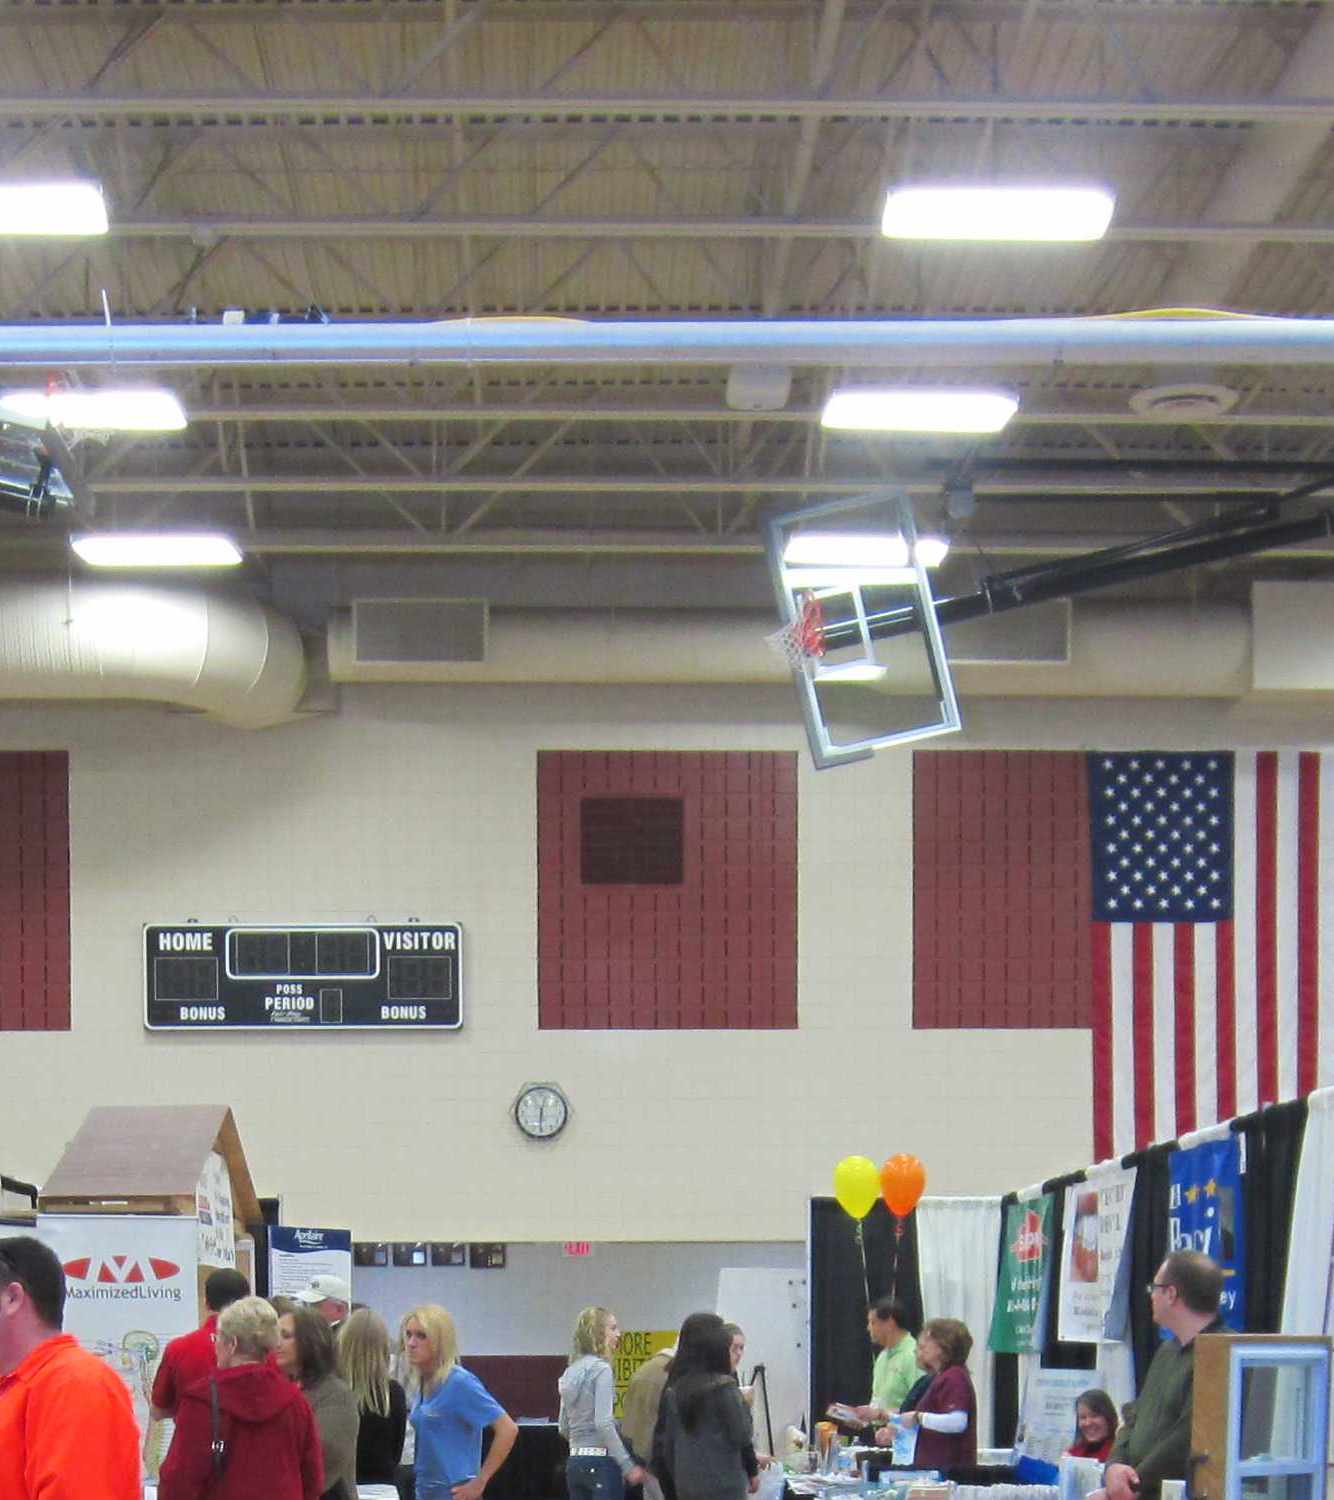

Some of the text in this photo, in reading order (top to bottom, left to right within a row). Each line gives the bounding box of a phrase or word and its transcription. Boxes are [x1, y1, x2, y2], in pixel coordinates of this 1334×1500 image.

[158, 932, 213, 951] HOME
[383, 932, 456, 950] VISITOR
[276, 983, 303, 995] POSS
[265, 996, 315, 1010] PERIOD
[180, 1006, 226, 1020] BONUS
[381, 1005, 427, 1019] BONUS
[569, 1241, 590, 1256] EXIT
[67, 1286, 181, 1302] MaximizedLiving
